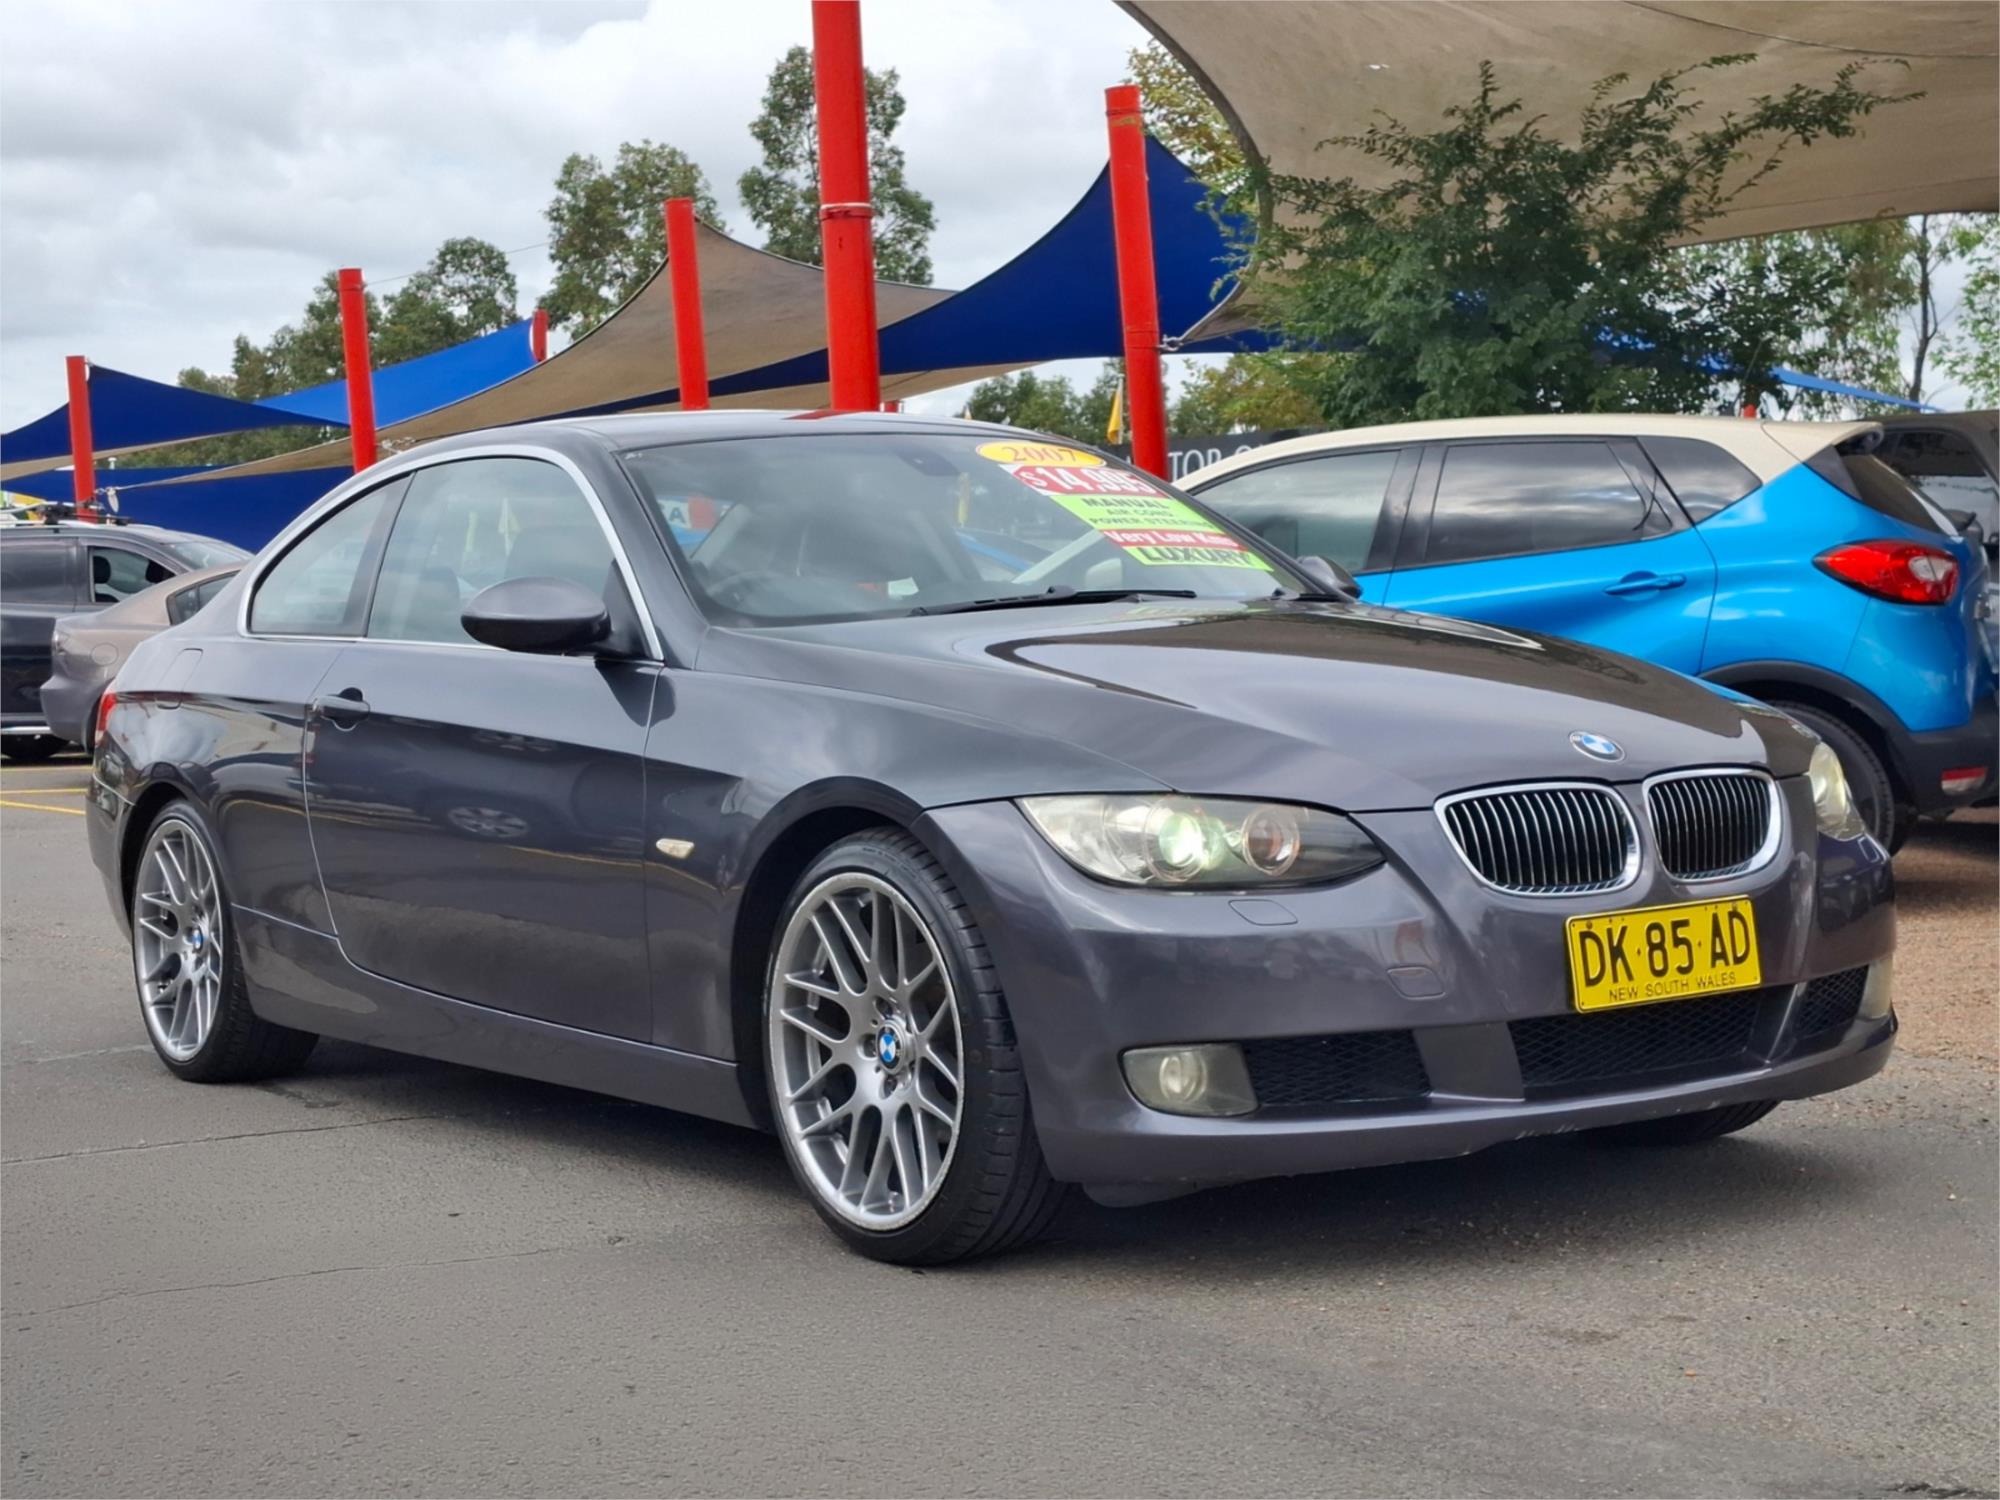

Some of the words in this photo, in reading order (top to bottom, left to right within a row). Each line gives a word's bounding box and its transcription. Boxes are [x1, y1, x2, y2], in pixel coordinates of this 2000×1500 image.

[1002, 447, 1077, 462] 2007
[1082, 498, 1170, 509] MANUAL
[1137, 546, 1251, 564] LUXURY
[1579, 925, 1634, 987] DK
[1645, 918, 1694, 978] 85
[1711, 910, 1750, 969] AD
[1609, 986, 1638, 1002] NEW
[1645, 980, 1690, 997] SOUTH
[1696, 972, 1736, 988] WALES
